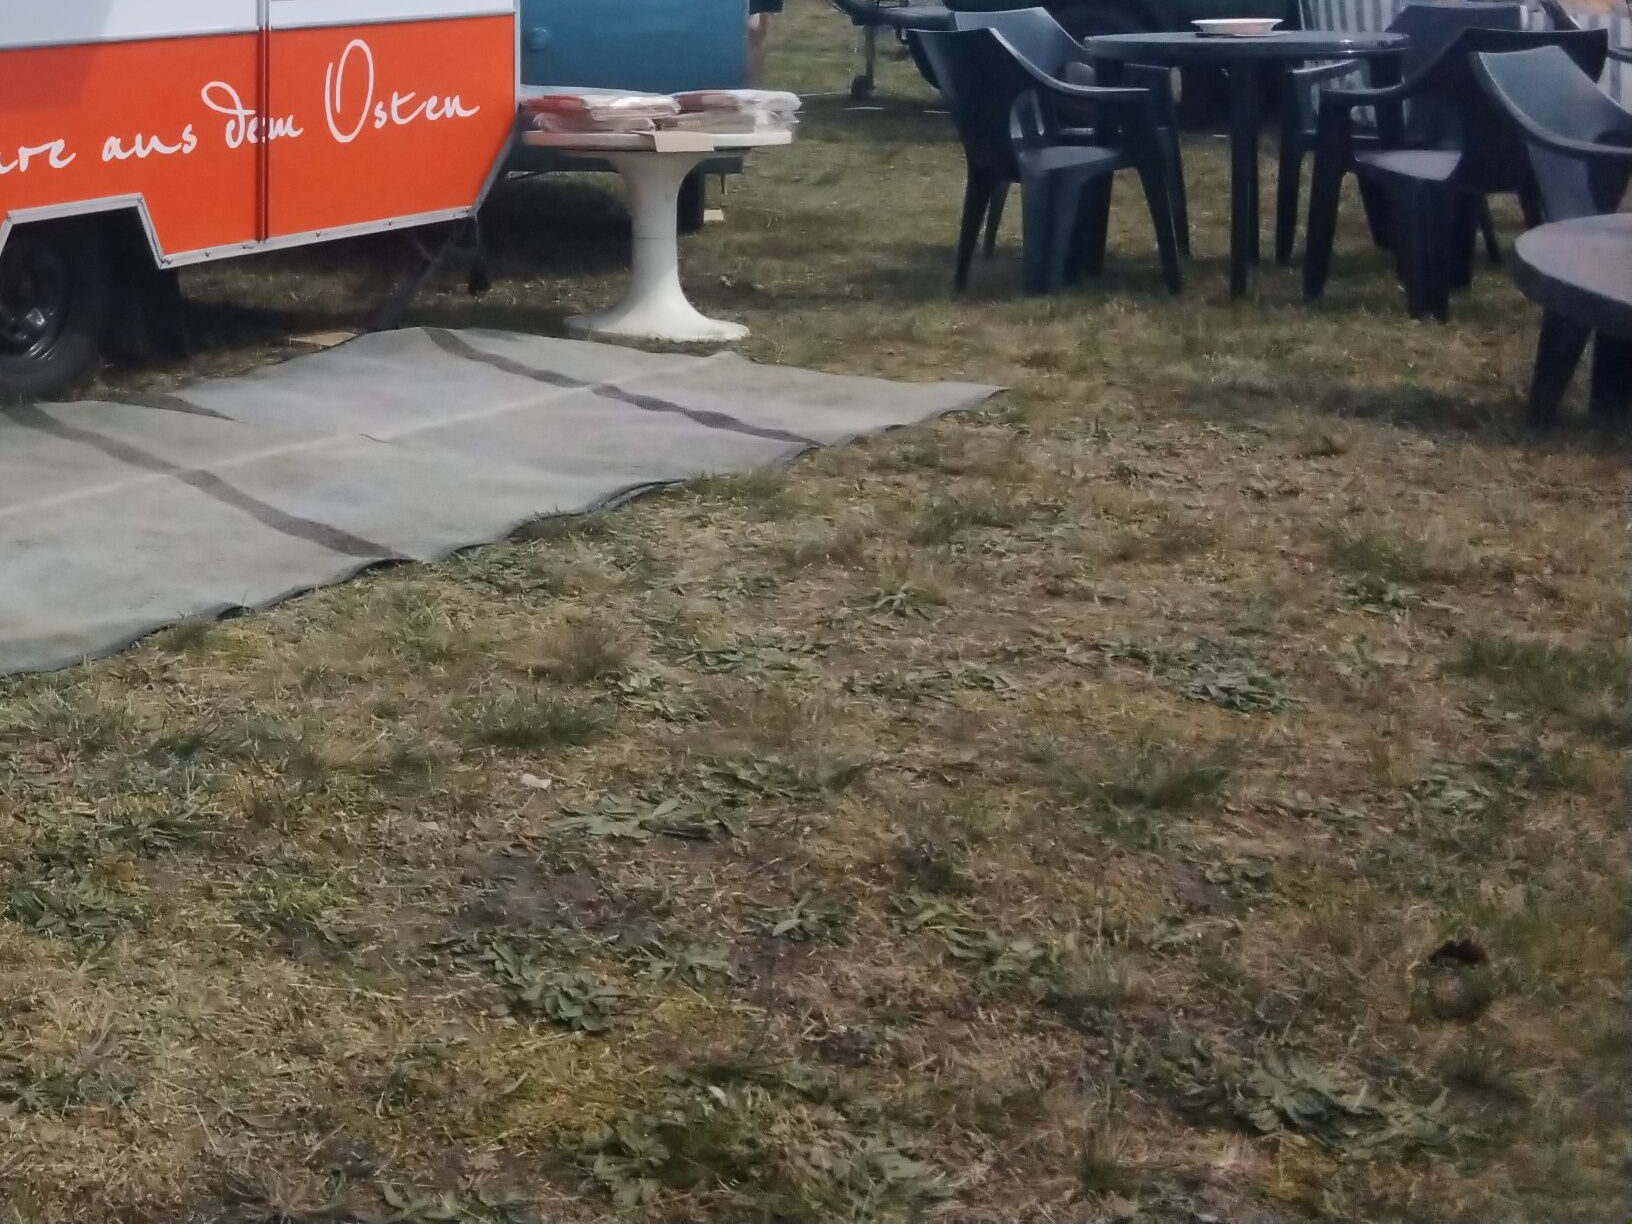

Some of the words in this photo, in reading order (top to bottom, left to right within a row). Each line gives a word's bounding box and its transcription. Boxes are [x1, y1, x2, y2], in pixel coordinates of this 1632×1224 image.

[100, 123, 199, 161] aus
[200, 80, 305, 151] dem
[323, 38, 482, 145] Osten
